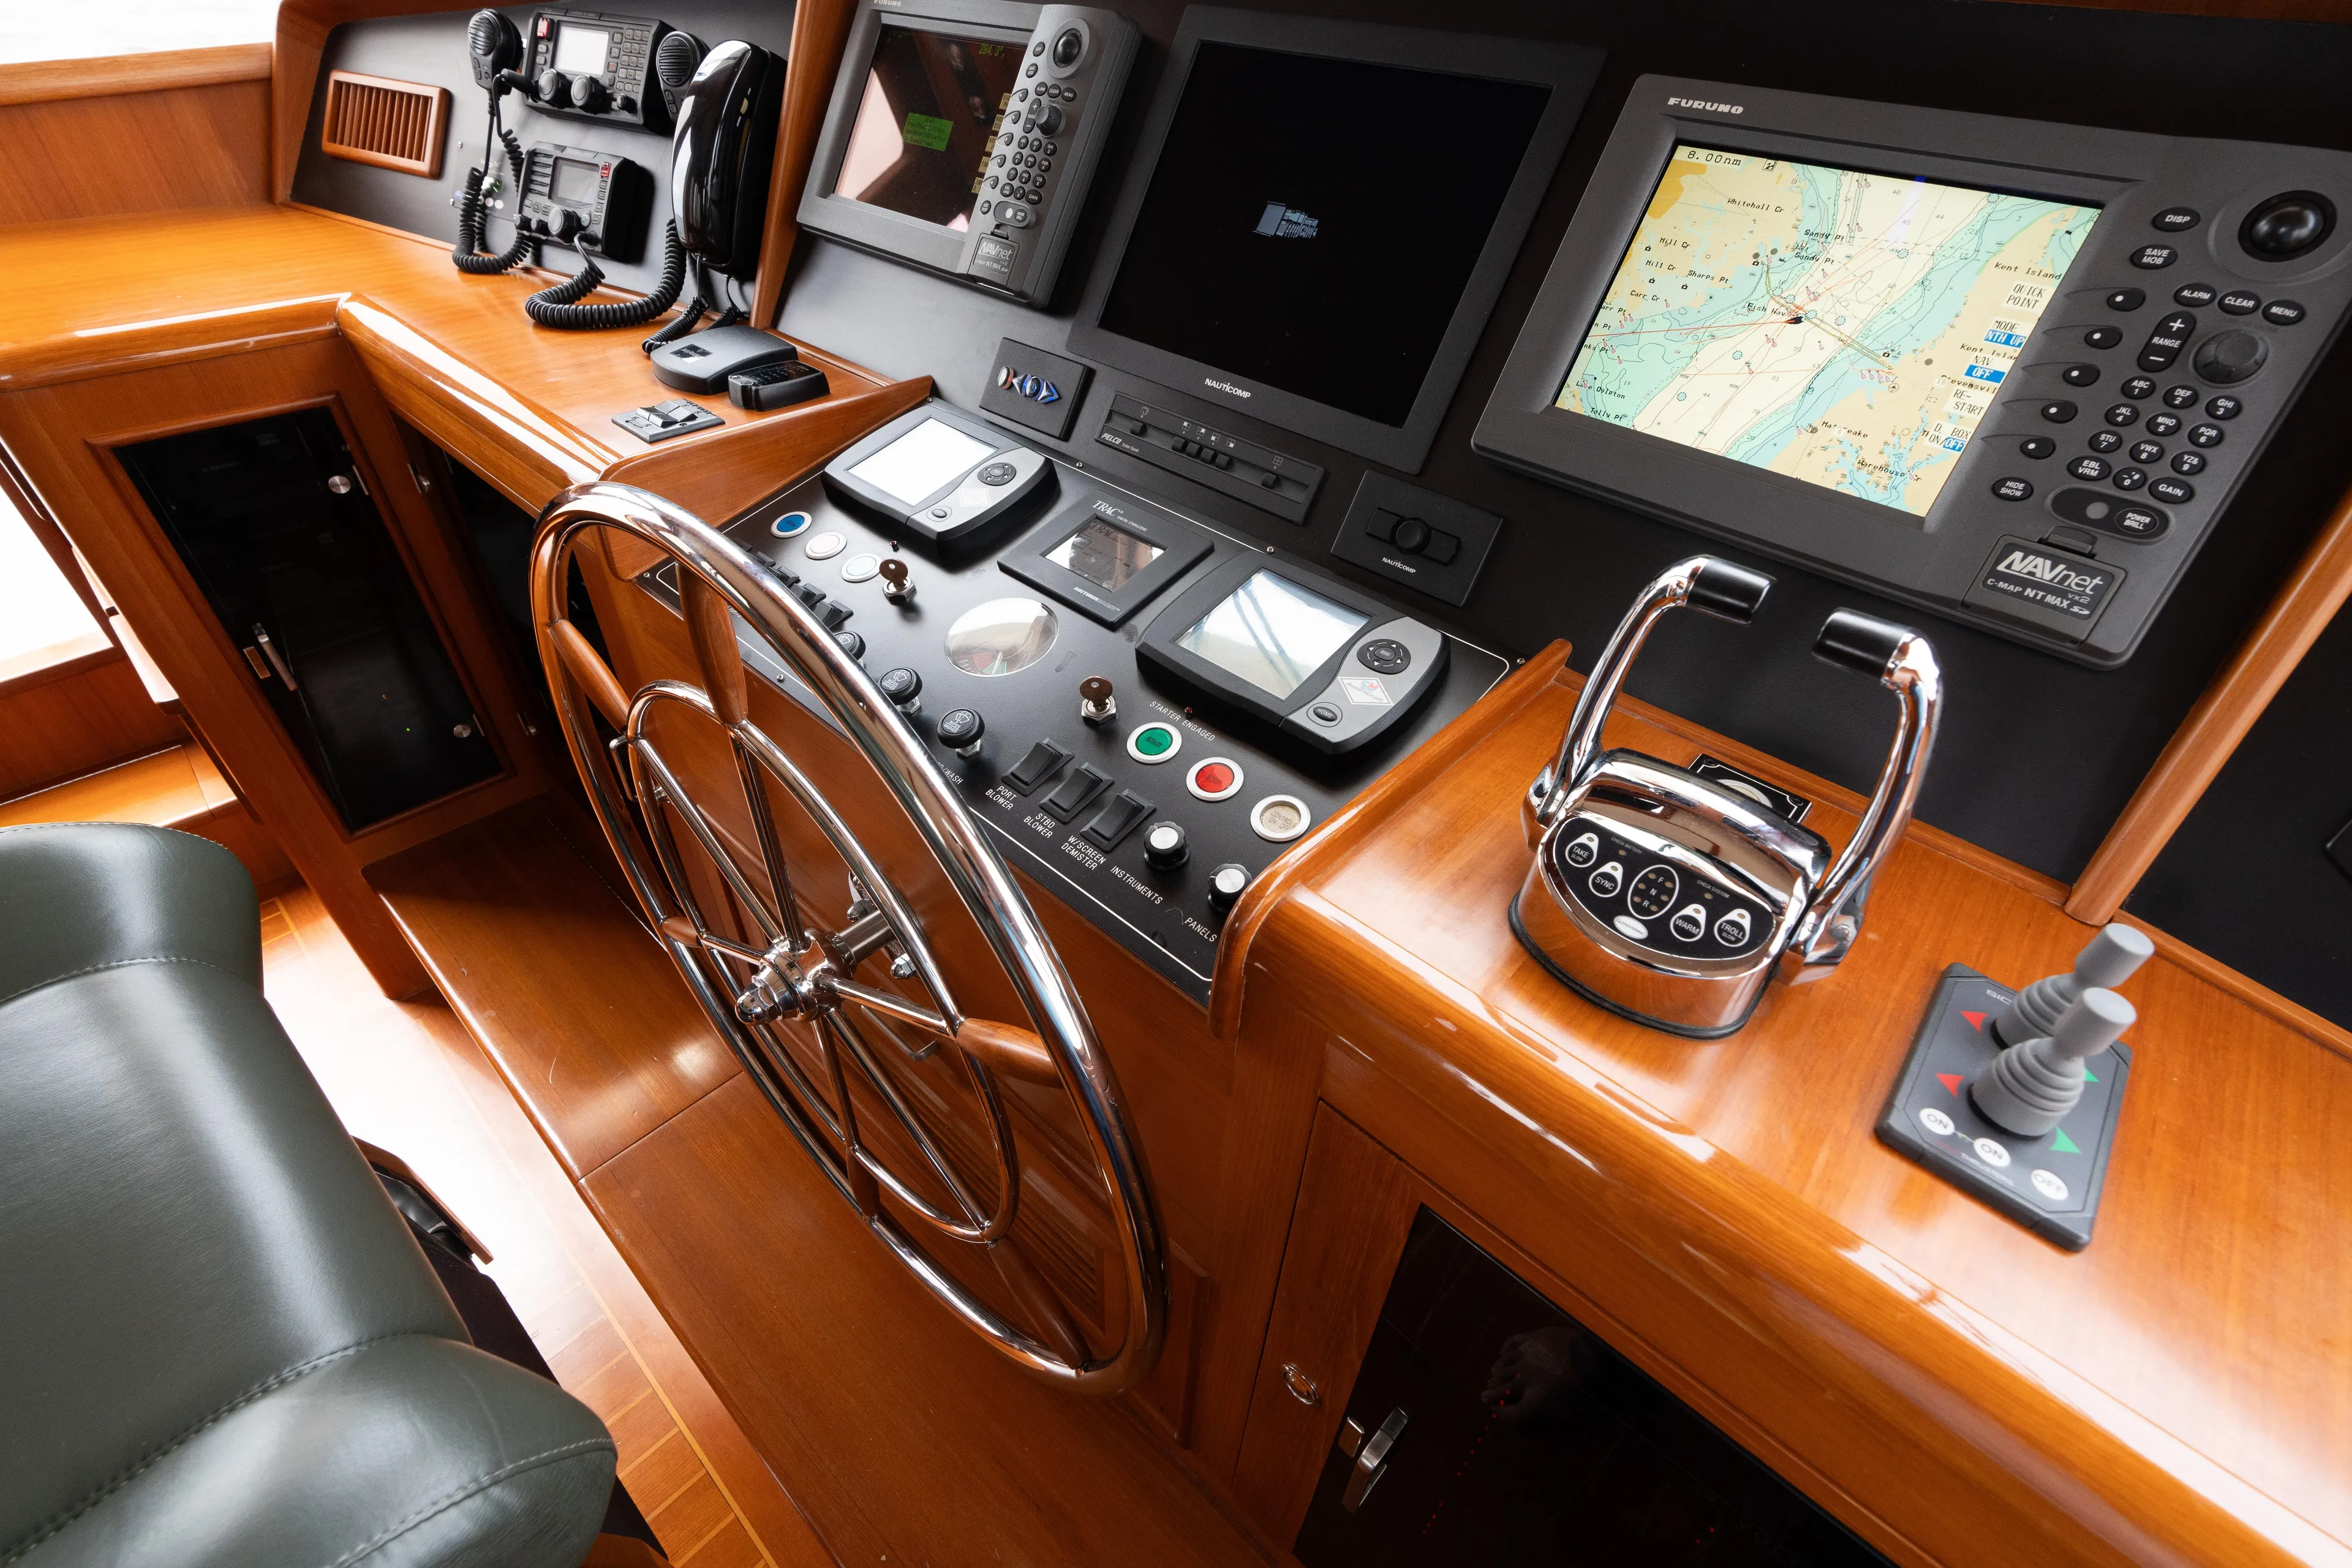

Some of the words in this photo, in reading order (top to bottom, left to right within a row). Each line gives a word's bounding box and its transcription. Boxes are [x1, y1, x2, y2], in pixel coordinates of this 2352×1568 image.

[1667, 97, 1743, 115] FURUNO
[1727, 197, 1770, 211] Whitehall
[2164, 214, 2190, 224] DISP
[1804, 229, 1830, 239] Sandy
[1659, 237, 1678, 246] Mill
[1795, 252, 1820, 262] Sandy
[2144, 247, 2170, 258] SAVE
[1645, 260, 1663, 269] Mill
[2141, 255, 2165, 265] MOB
[1687, 270, 1715, 282] Sharps
[1994, 262, 2019, 273] Kent
[2026, 267, 2062, 280] Island
[1630, 290, 1647, 299] Carr
[2013, 284, 2046, 298] QUICK
[2180, 289, 2211, 300] ALARM
[2006, 295, 2039, 309] POINT
[2224, 296, 2255, 308] CLEAR
[2269, 306, 2298, 317] MENU
[1992, 319, 2020, 333] MODE
[1987, 330, 2007, 344] NTH
[2010, 335, 2025, 347] UP
[2152, 336, 2182, 348] RANGE
[1960, 343, 1984, 354] Kent
[1972, 354, 1994, 366] NAV
[1972, 366, 1994, 379] OFF
[1576, 380, 1593, 390] Lae
[2131, 379, 2150, 389] ABC
[1953, 389, 1971, 399] RE-
[2174, 389, 2193, 398] DEF
[1953, 401, 1985, 416] START
[2217, 399, 2234, 409] GHI
[1591, 407, 1610, 418] Tolly
[2116, 407, 2132, 415] JKL
[2157, 416, 2176, 426] MNO
[1950, 428, 1972, 440] BOX
[2198, 427, 2218, 437] PQR
[1101, 432, 1122, 445] PELCO
[2099, 434, 2117, 443] STU
[2139, 443, 2160, 454] VWX
[2082, 459, 2100, 470] EBL
[2182, 454, 2199, 465] YZ&
[1857, 459, 1905, 478] Warehouse
[2078, 466, 2099, 477] VRM
[2005, 480, 2026, 490] HIDE
[2158, 484, 2184, 497] GAIN
[1999, 487, 2023, 497] SHOW
[2125, 512, 2150, 524] POWER
[1128, 521, 1148, 532] STABILIZERS
[2124, 519, 2144, 530] BRILL
[1996, 551, 2104, 595] NAVnet
[1987, 578, 2022, 593] C-MAP
[2024, 587, 2046, 601] NT
[2045, 594, 2071, 609] MAX
[882, 682, 895, 690] WASHER
[1346, 682, 1384, 703] SmartCraft
[1317, 708, 1333, 719] HOME
[949, 720, 961, 729] WIPER
[1150, 701, 1182, 722] STARTER
[1182, 719, 1215, 742] ENGAGED
[943, 723, 957, 733] WASHER
[1146, 736, 1163, 748] START
[1205, 774, 1221, 785] STOP
[986, 789, 1014, 810] BLOWER
[997, 786, 1017, 801] PORT
[1035, 813, 1055, 829] STBD
[1271, 811, 1298, 827] CONTROLS
[1023, 816, 1053, 839] BLOWER
[1068, 835, 1106, 865] W/SCREEN
[1611, 836, 1624, 847] CHECK
[1623, 842, 1643, 855] BATTERY
[1061, 842, 1098, 870] DEMISTER
[1570, 853, 1584, 862] SLOW
[1572, 845, 1589, 859] TAKE
[1110, 865, 1163, 905] INSTRUMENTS
[1594, 876, 1615, 891] SYNC
[1697, 880, 1713, 891] CHECK
[1712, 886, 1730, 899] SYSTEM
[1185, 917, 1218, 943] PANELS
[1675, 918, 1700, 935] WARM
[1720, 922, 1744, 940] TROLL
[1722, 932, 1737, 942] SLOW
[1925, 1114, 1950, 1130] ON
[1981, 1143, 2003, 1160] ON
